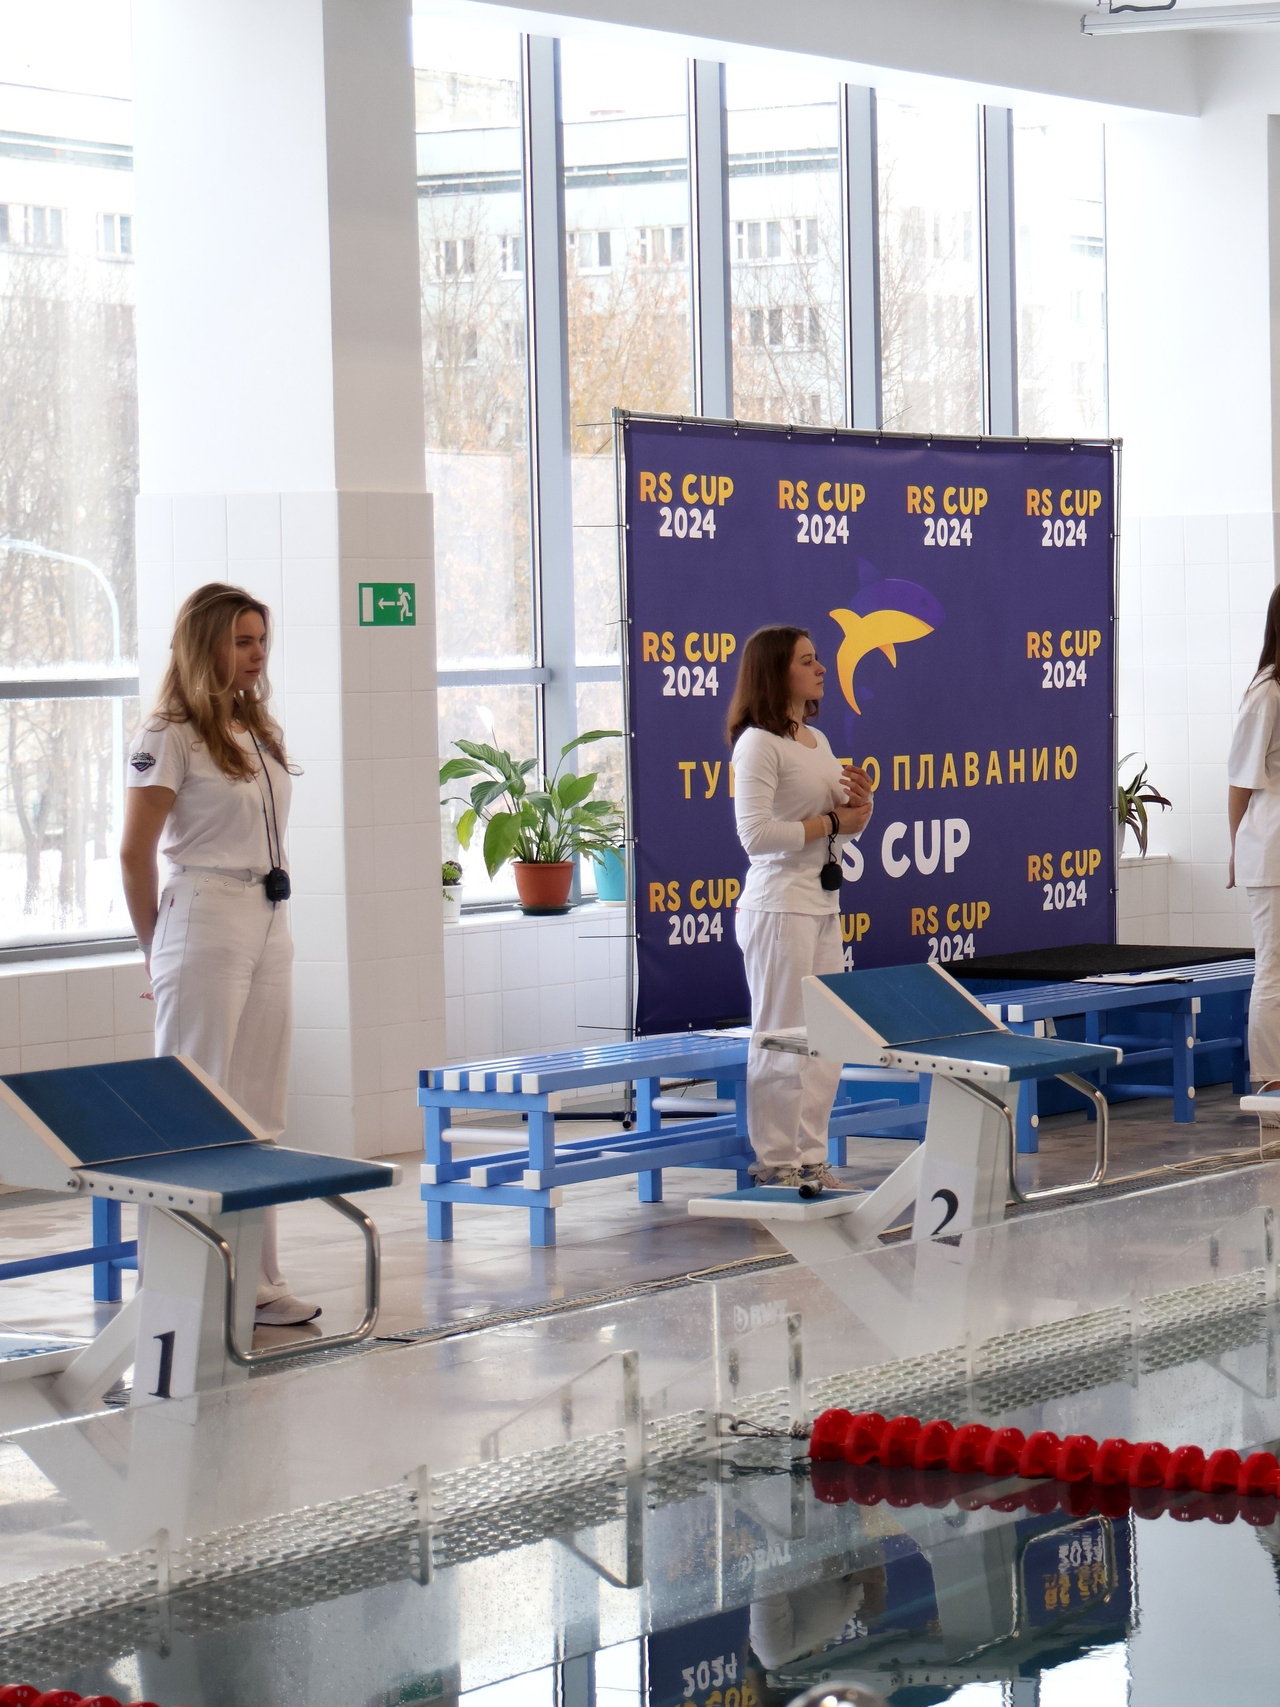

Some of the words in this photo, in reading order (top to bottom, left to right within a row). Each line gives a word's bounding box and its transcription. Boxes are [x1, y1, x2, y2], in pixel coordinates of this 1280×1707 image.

[639, 471, 672, 504] RS
[681, 473, 734, 506] CUP
[778, 480, 809, 511] RS
[817, 482, 865, 512] CUP
[906, 485, 935, 514] RS
[942, 486, 988, 515] CUP
[1026, 488, 1053, 516] RS
[1059, 489, 1101, 517] CUP
[658, 506, 717, 540] 2024
[796, 513, 850, 545] 2024
[923, 517, 973, 548] 2024
[1041, 518, 1088, 548] 2024
[642, 631, 675, 663] RS
[684, 632, 736, 663] CUP
[1026, 631, 1053, 659] RS
[1059, 629, 1101, 658] CUP
[662, 665, 719, 698] 2024
[1041, 659, 1088, 689] 2024
[893, 745, 1078, 791] ПЛАВАНИЮ
[881, 817, 971, 878] CUP
[1027, 853, 1054, 882] RS
[1060, 848, 1102, 878] CUP
[649, 880, 687, 913] RS
[689, 878, 741, 910] CUP
[1042, 879, 1088, 911] 2024
[668, 912, 724, 946] 2024
[840, 912, 871, 943] UP
[911, 905, 939, 936] RS
[946, 901, 991, 932] CUP
[926, 933, 976, 969] 2024
[930, 1188, 963, 1248] 2
[148, 1330, 176, 1400] 1
